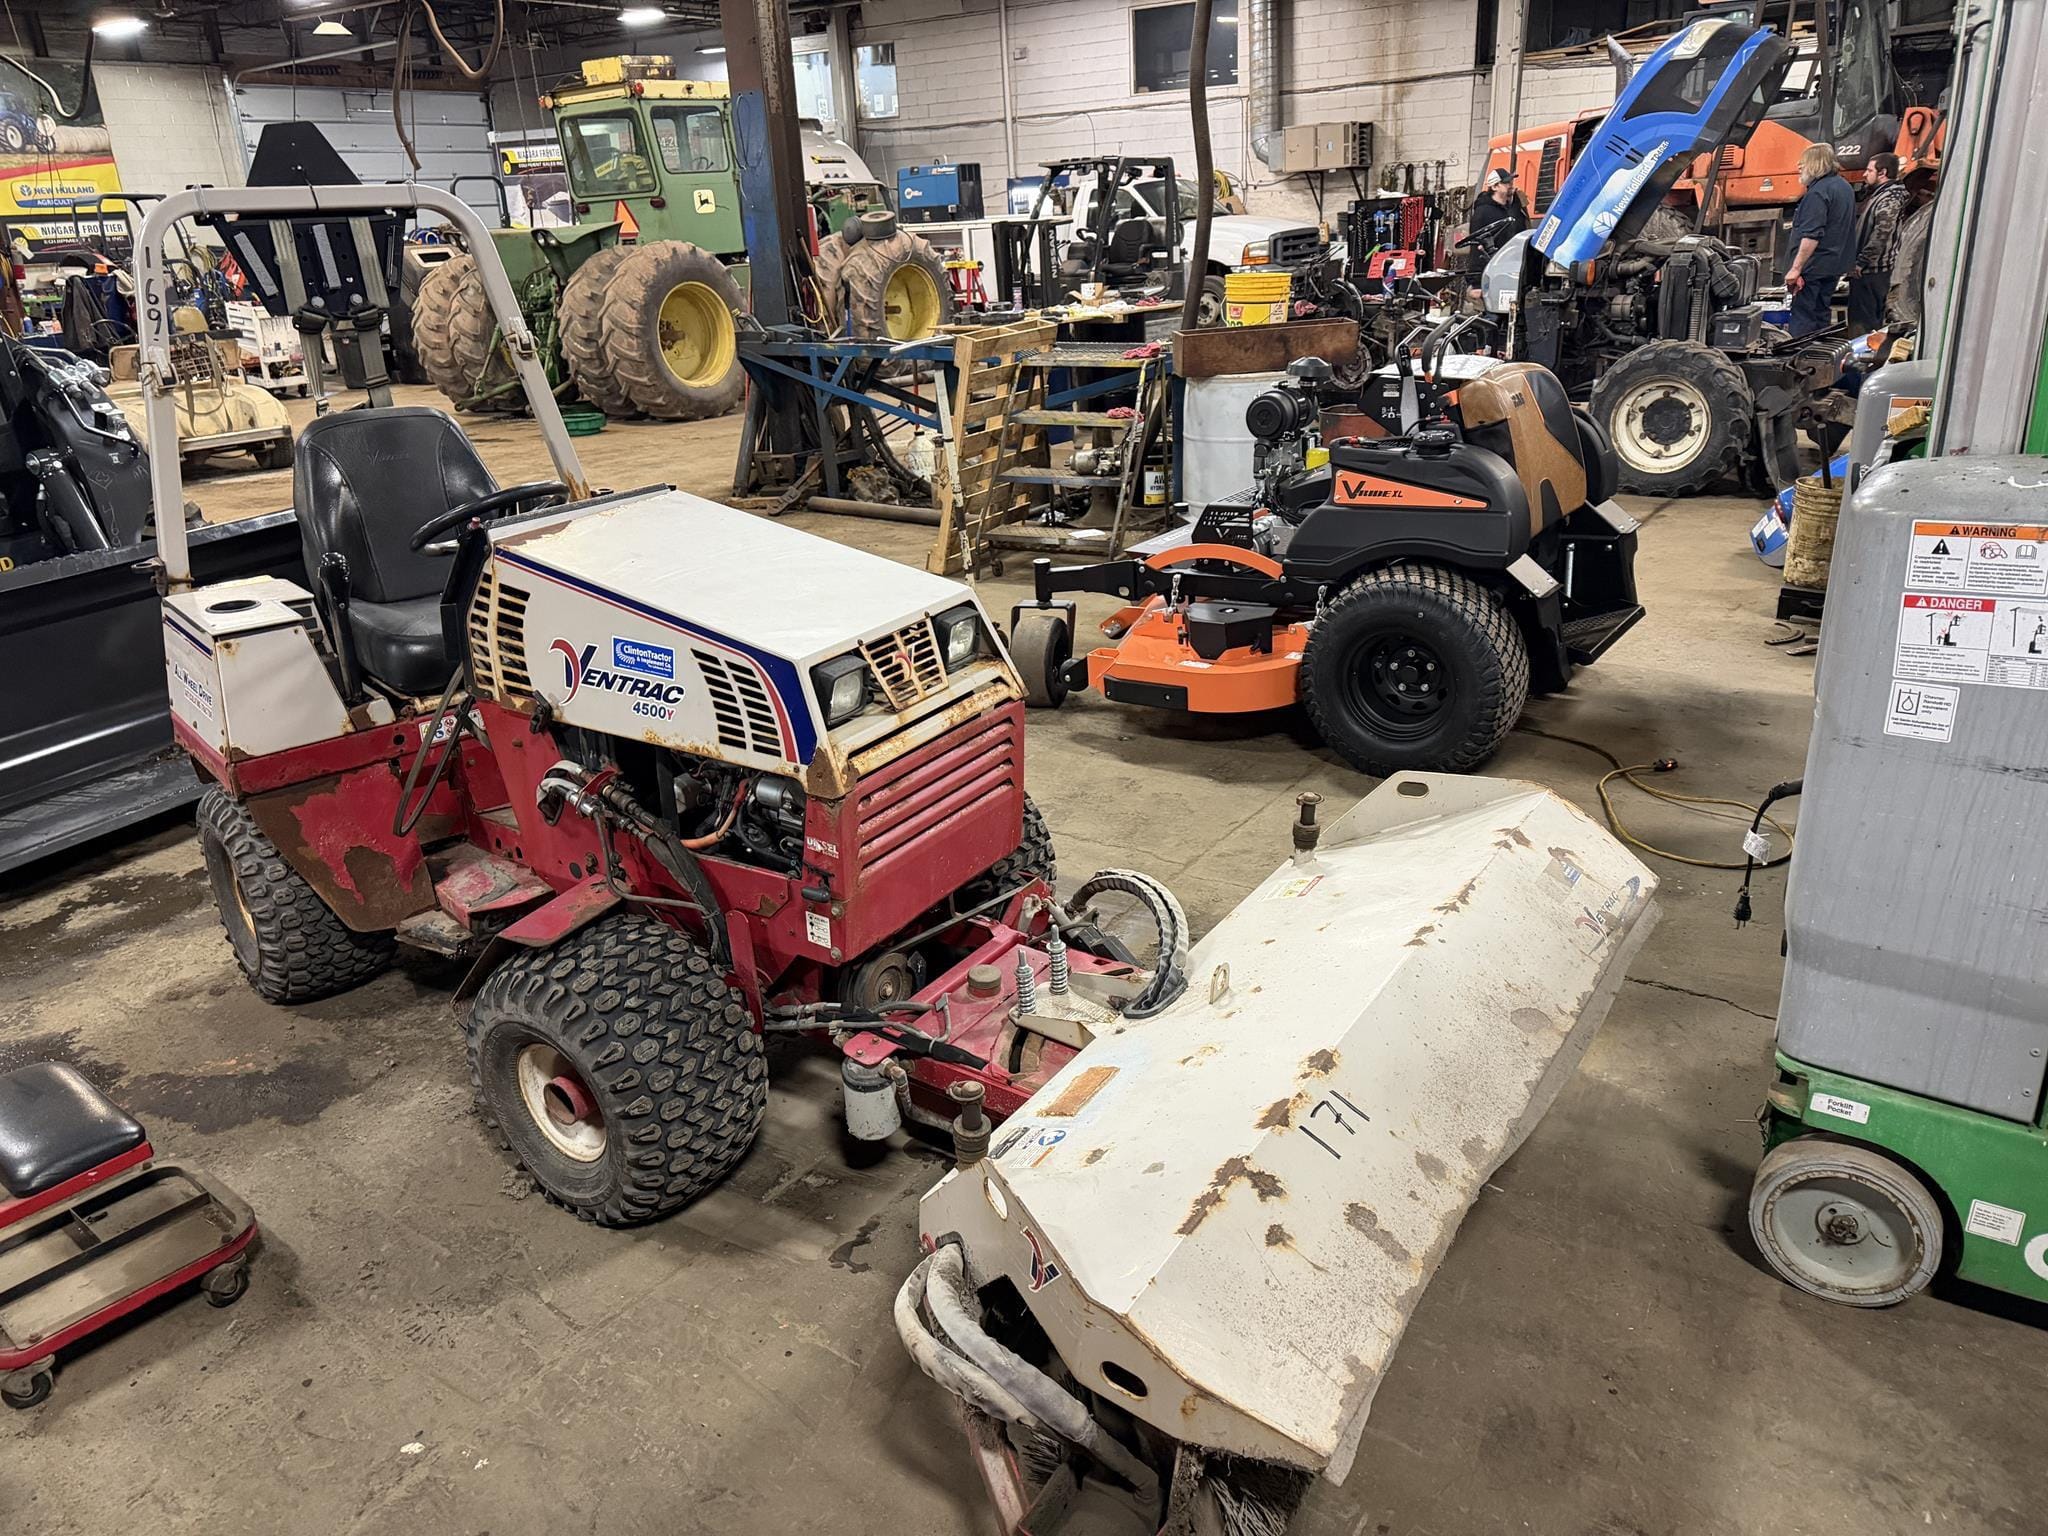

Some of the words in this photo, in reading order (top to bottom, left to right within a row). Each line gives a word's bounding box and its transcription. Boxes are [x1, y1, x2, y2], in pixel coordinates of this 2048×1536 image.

[1837, 145, 1861, 156] 222
[55, 186, 95, 195] HOLLAND
[1612, 193, 1631, 217] New
[1626, 162, 1651, 196] Holland
[1048, 229, 1058, 279] NISSAN
[1391, 490, 1403, 498] XL
[1962, 526, 2017, 538] WARNING
[1930, 598, 1983, 611] DANGER
[549, 639, 685, 705] VENTRAC
[633, 702, 675, 720] 4500Y
[1828, 1098, 1854, 1110] Forklift
[1828, 1105, 1852, 1116] Pocket
[1298, 1090, 1370, 1160] 171
